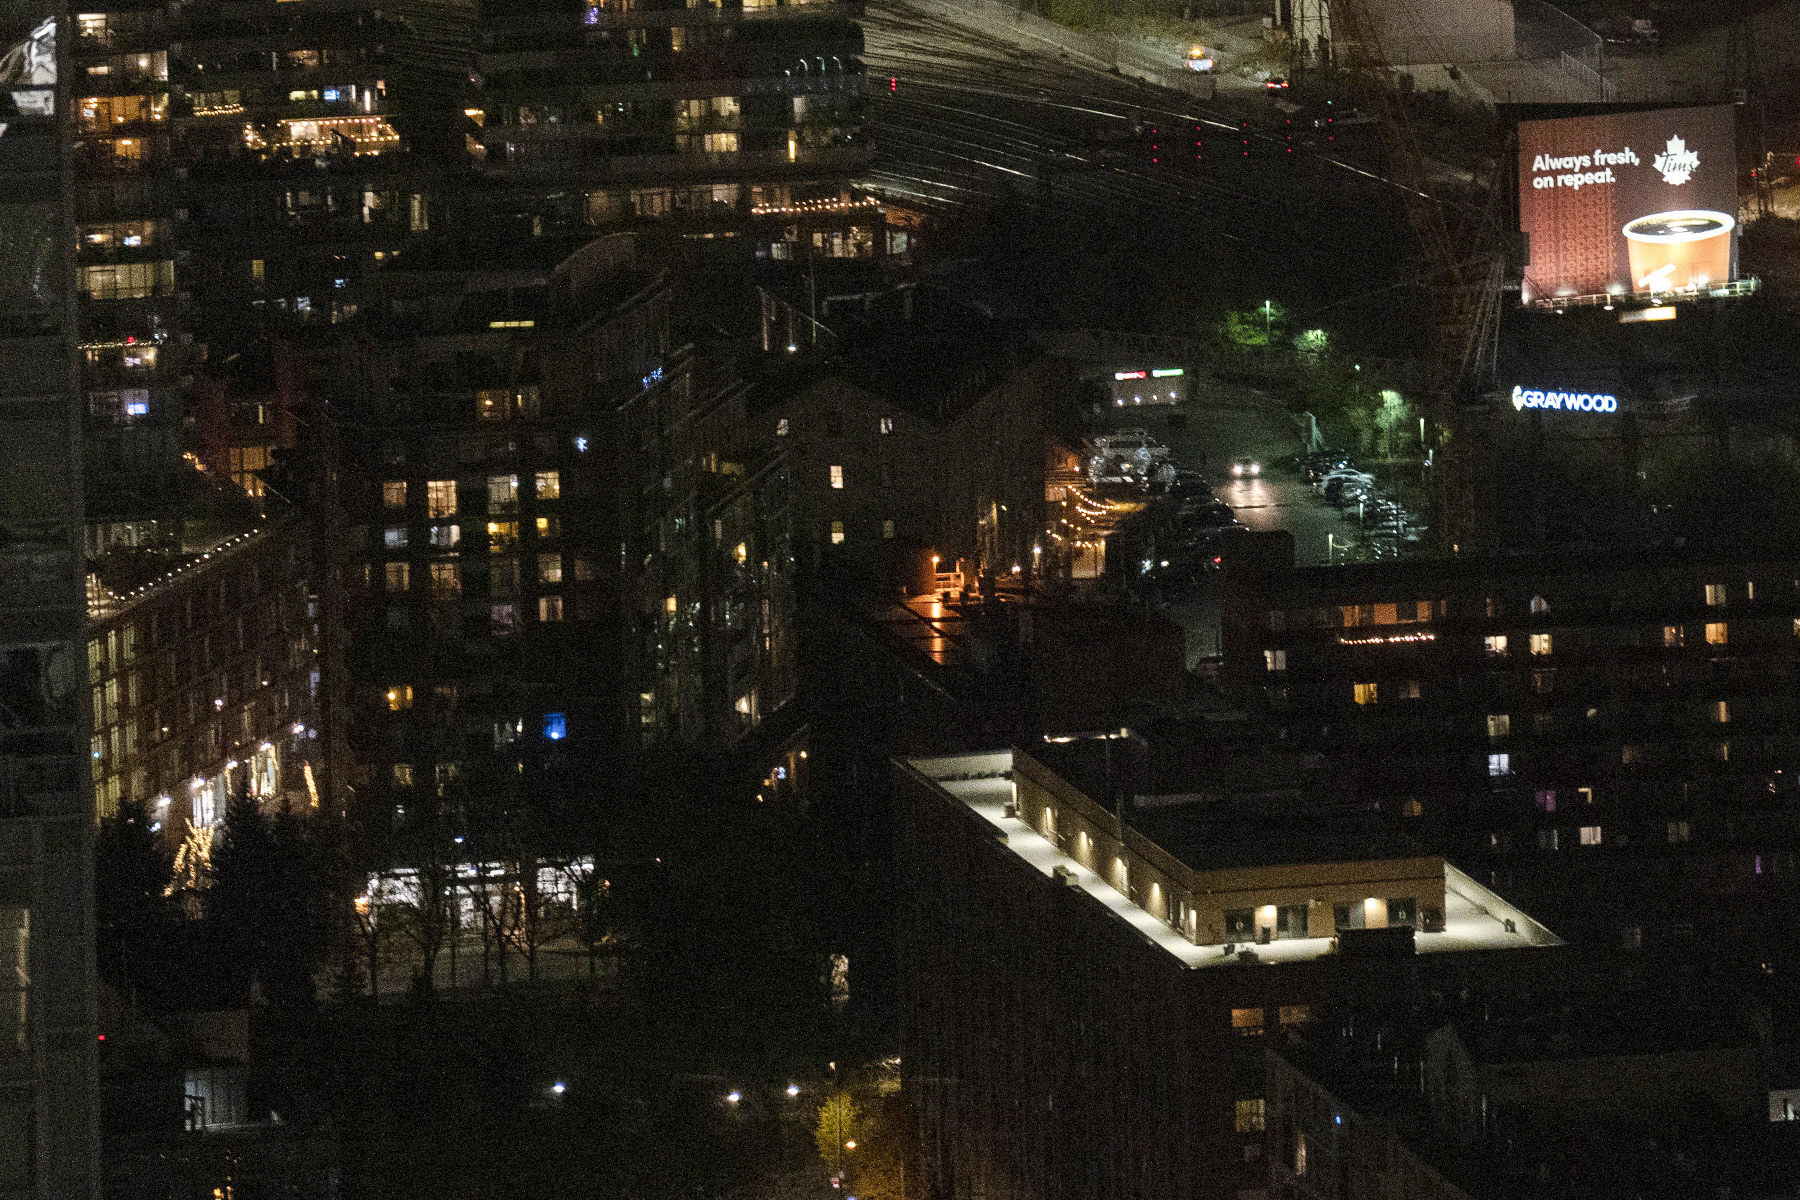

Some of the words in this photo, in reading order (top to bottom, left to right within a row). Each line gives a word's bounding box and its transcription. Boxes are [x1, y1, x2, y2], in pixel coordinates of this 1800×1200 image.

[1532, 153, 1592, 173] Always
[1593, 146, 1640, 166] fresh,
[1660, 152, 1696, 173] Tims
[1532, 175, 1555, 189] on
[1556, 167, 1617, 190] repeat.
[1522, 389, 1618, 413] GRAYWOOD
